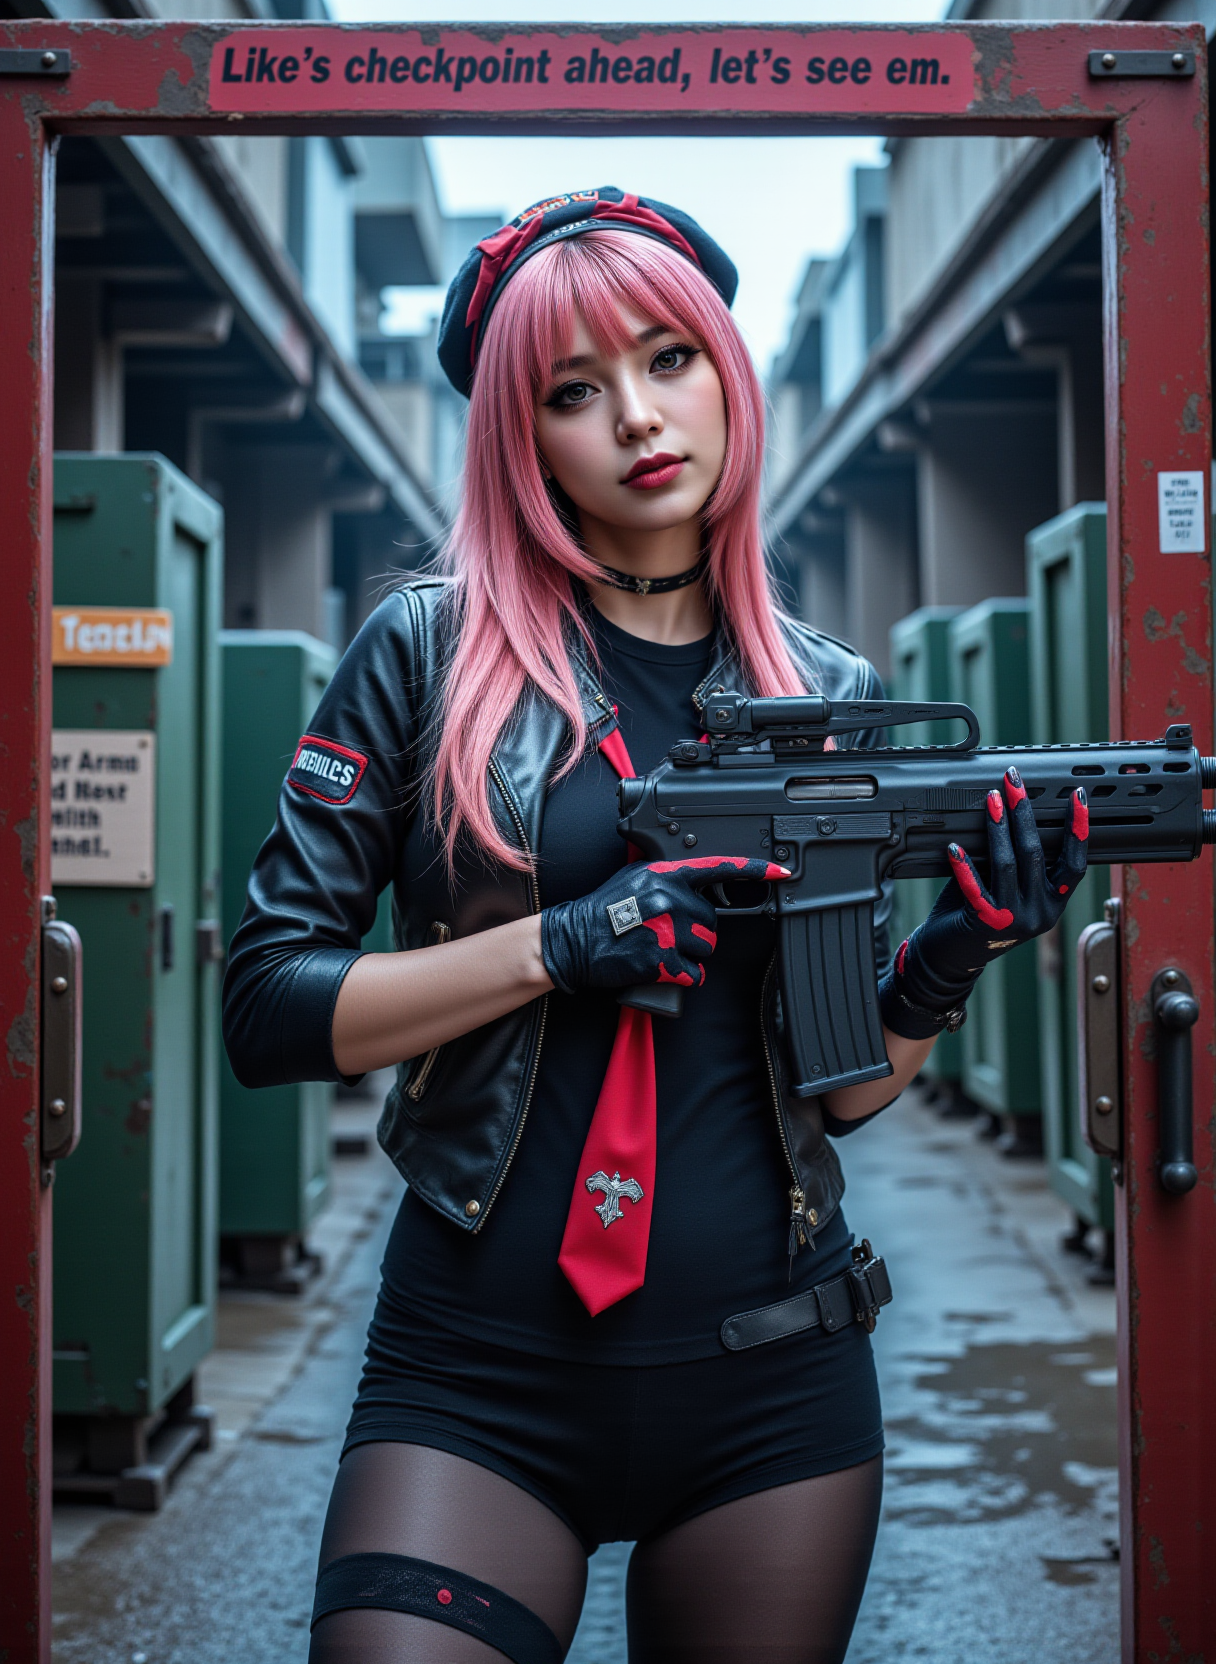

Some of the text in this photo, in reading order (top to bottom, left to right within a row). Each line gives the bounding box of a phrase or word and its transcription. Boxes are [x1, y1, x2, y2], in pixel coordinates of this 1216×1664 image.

[221, 47, 951, 93] Like's checkpoint ahead, let's see em.
